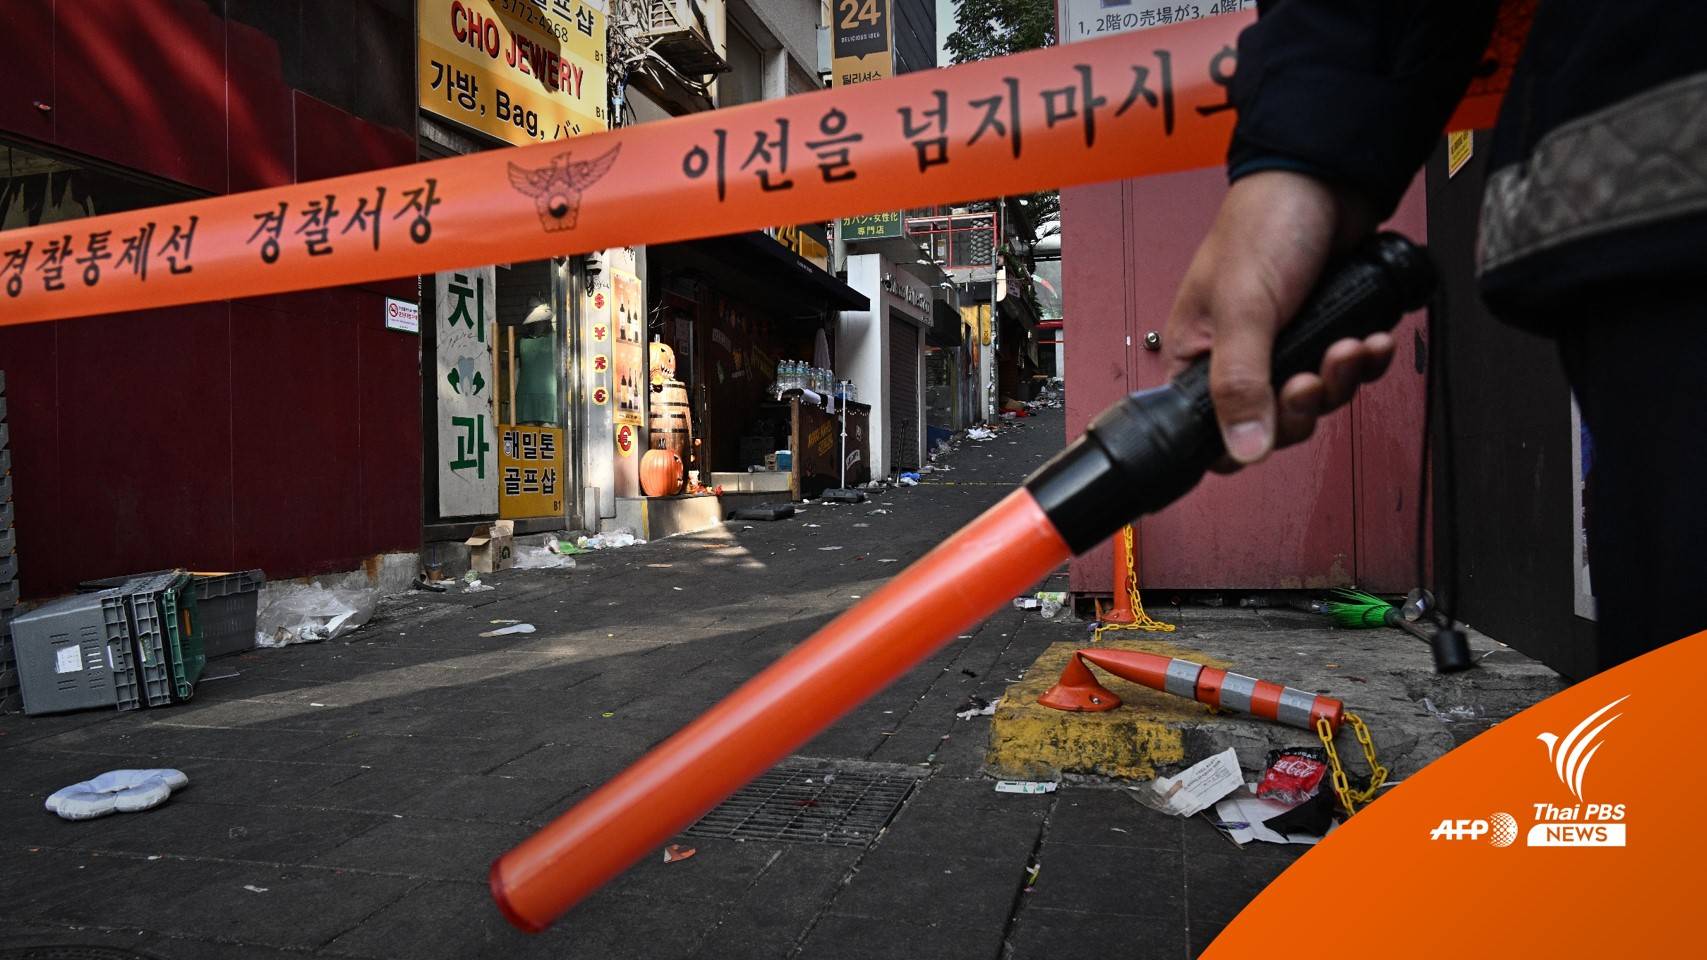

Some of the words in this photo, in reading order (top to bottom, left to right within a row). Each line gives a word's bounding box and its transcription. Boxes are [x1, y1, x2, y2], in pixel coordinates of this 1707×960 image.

[840, 0, 881, 29] 24
[451, 0, 500, 59] CHO
[505, 31, 584, 100] JEWERY
[841, 33, 868, 43] DELICIOUS
[594, 50, 604, 64] B1
[431, 60, 486, 116] 가방,
[496, 89, 545, 140] Bag,
[595, 106, 605, 120] B1
[0, 216, 198, 298] 경찰통제선
[246, 178, 441, 265] 경찰서장
[683, 107, 863, 202] 이선을
[448, 273, 490, 480] 치과
[503, 431, 555, 461] 해밀톤
[504, 467, 556, 496] 골프샵
[553, 500, 561, 511] B1
